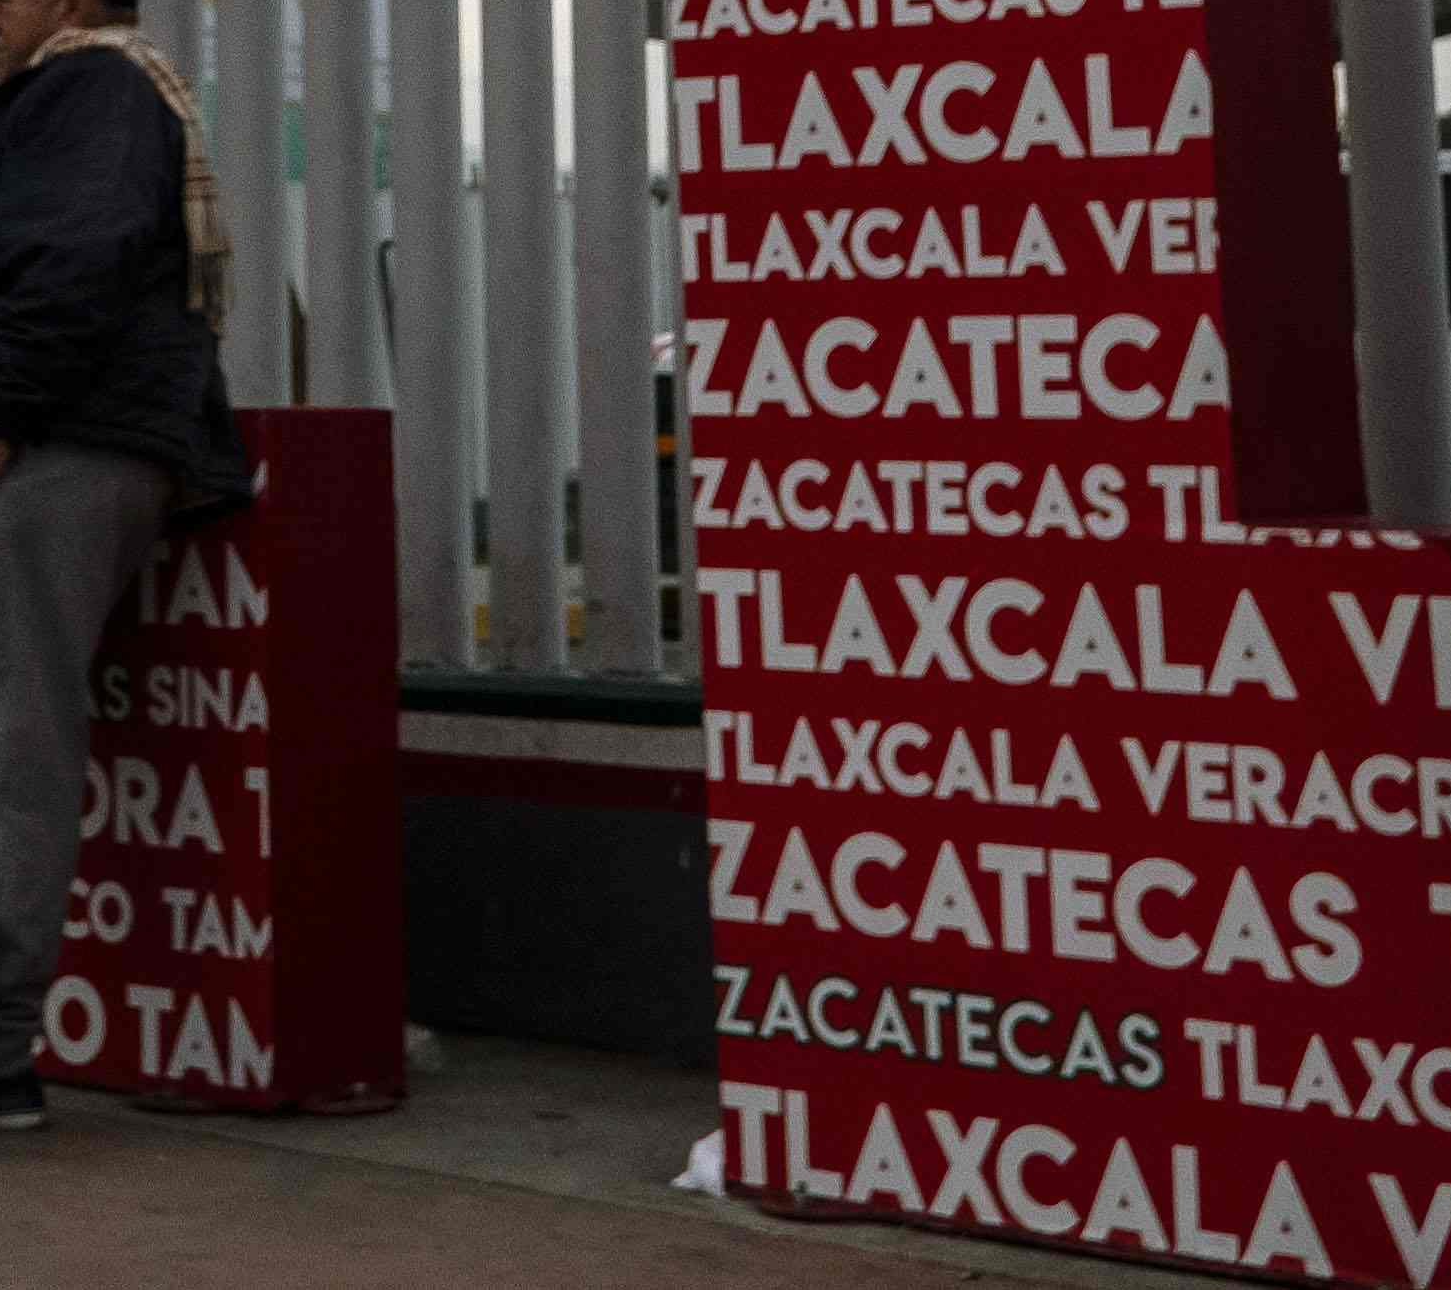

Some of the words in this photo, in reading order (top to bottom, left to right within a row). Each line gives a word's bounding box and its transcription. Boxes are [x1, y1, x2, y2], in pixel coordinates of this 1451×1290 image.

[678, 50, 1212, 172] TLAXCALA
[685, 205, 1065, 282] TLAXCALA
[690, 314, 1229, 419] ZACATECA
[697, 458, 1128, 539] ZACATECAS
[701, 568, 1296, 699] TLAXCALA
[707, 710, 1098, 810] TLAXCALA
[711, 819, 1361, 986] ZACATECAS
[717, 966, 1162, 1087] ZACATECAS
[722, 1082, 1333, 1278] TLAXCALA
